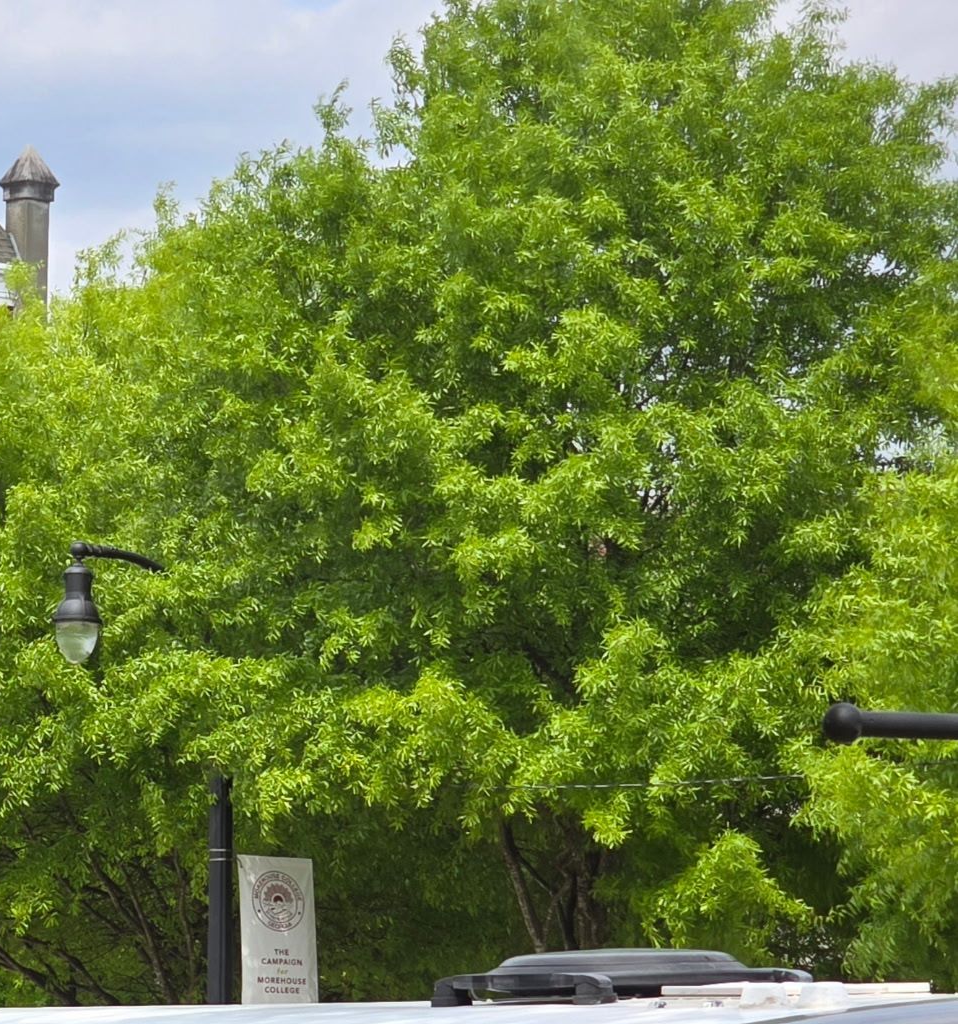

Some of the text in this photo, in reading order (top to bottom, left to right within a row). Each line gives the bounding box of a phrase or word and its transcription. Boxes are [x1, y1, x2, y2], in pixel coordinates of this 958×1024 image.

[273, 948, 290, 956] THE
[261, 957, 303, 966] CAMPAIGN
[276, 967, 289, 975] for
[257, 976, 307, 985] MOREHOUSE
[264, 986, 300, 994] COLLEGE
